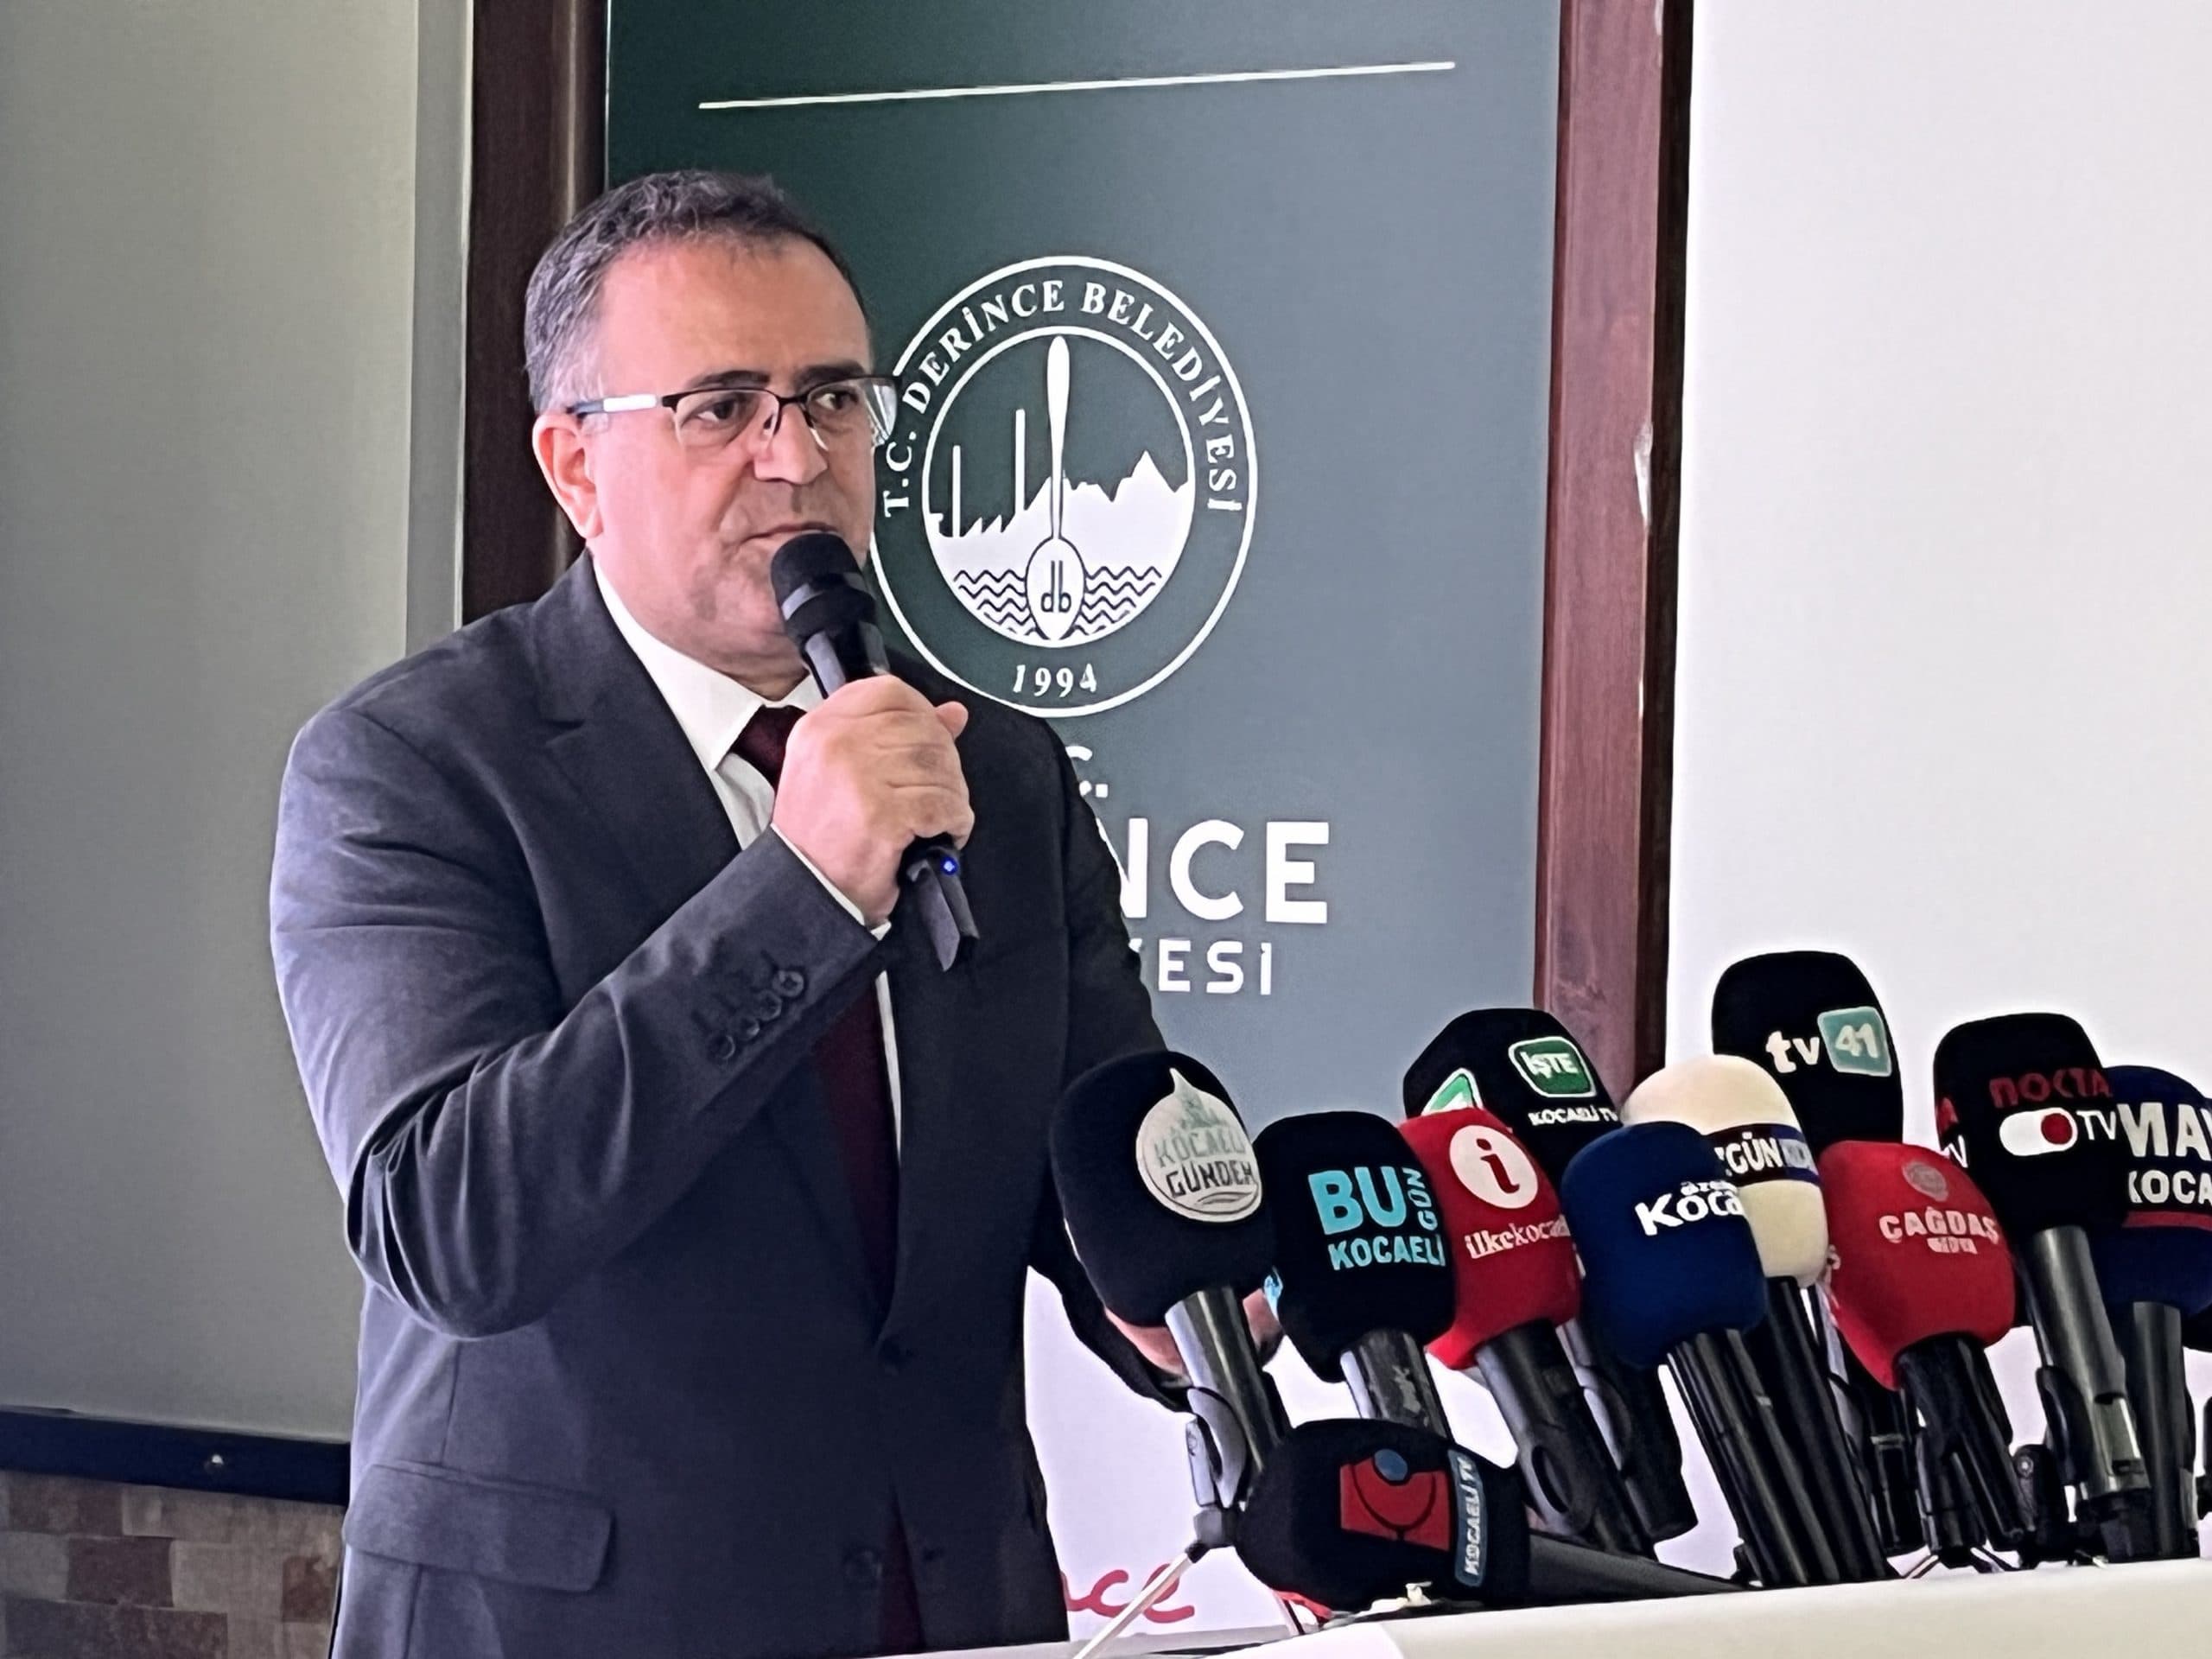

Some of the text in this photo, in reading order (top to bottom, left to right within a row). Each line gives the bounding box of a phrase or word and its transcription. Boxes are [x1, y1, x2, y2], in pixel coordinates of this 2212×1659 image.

[902, 279, 1065, 415] DERİNCE
[1080, 281, 1243, 514] BELEDİYESİ
[1012, 663, 1098, 697] 1994
[1128, 938, 1272, 995] ESİ
[1765, 1023, 1879, 1073] tv 41
[2075, 1109, 2117, 1141] TV
[1307, 1166, 1408, 1236] BU
